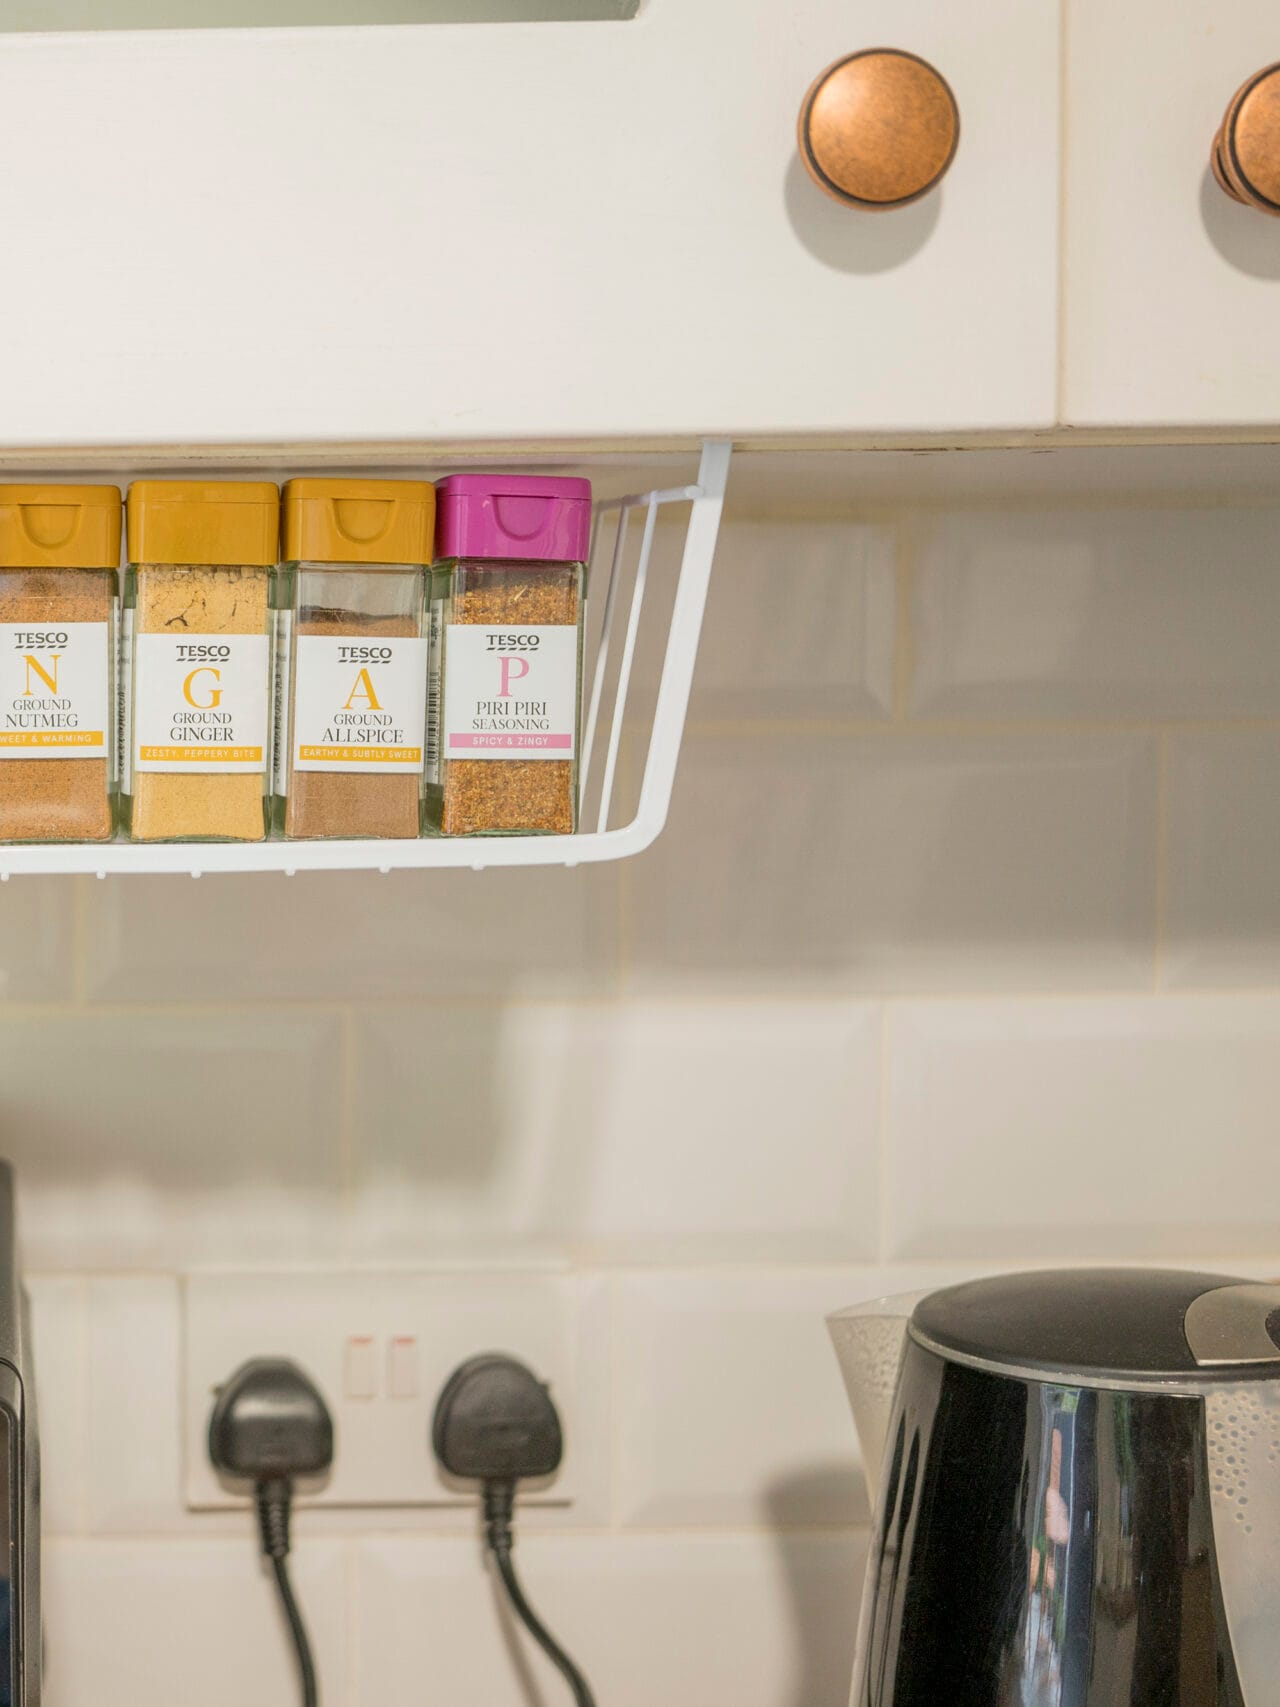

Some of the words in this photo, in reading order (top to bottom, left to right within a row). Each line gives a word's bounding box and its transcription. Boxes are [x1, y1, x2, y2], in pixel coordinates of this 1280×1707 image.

[14, 632, 68, 644] TESCO
[486, 634, 540, 646] TESCO
[176, 645, 230, 657] TESCO
[338, 647, 392, 659] TESCO
[22, 654, 62, 696] N
[497, 656, 530, 697] P
[183, 667, 223, 709] G
[341, 667, 384, 710] A
[12, 699, 71, 711] GROUND
[477, 701, 508, 715] PIRI
[515, 701, 547, 715] PIRI
[5, 714, 78, 728] NUTMEG
[173, 713, 232, 724] GROUND
[334, 714, 393, 726] GROUND
[472, 719, 550, 730] SEASONING
[170, 727, 234, 741] GINGER
[322, 728, 404, 744] ALLSPICE
[473, 737, 502, 745] SPICY
[518, 737, 548, 745] ZINGY
[233, 750, 254, 758] BITE
[304, 748, 339, 757] EARTHY
[352, 750, 385, 758] SUBTLY
[389, 751, 417, 759] SWEET
